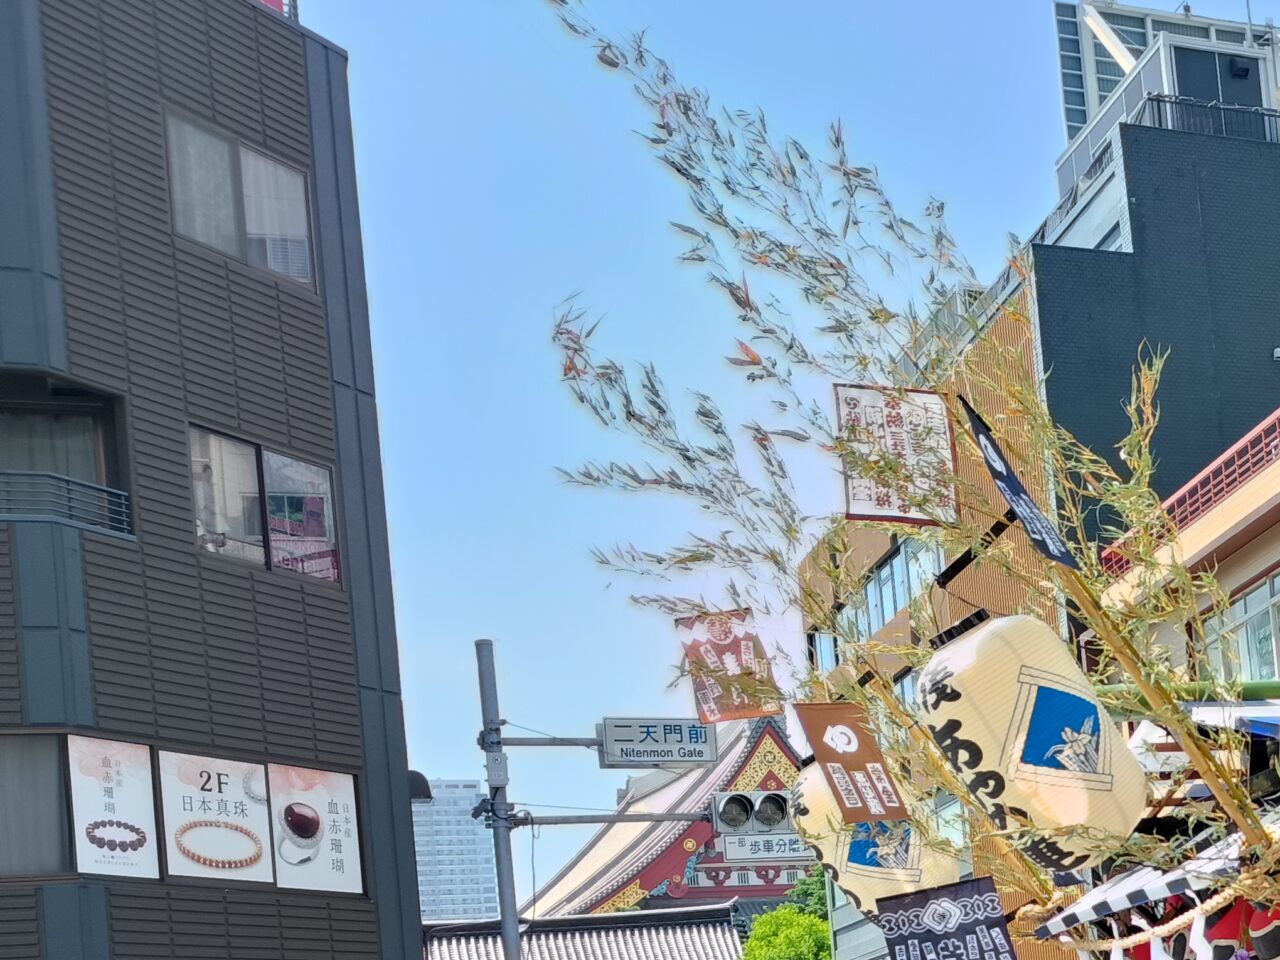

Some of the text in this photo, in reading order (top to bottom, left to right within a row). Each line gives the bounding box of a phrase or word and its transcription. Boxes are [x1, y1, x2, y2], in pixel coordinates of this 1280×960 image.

[614, 724, 708, 744] 二天門前
[620, 747, 704, 758] Nitenmon Gate
[101, 756, 116, 815] 血赤珊瑚
[199, 770, 229, 794] 2F
[181, 795, 249, 819] 日本真珠
[343, 803, 352, 838] 日本産
[327, 799, 345, 874] 血赤珊瑚
